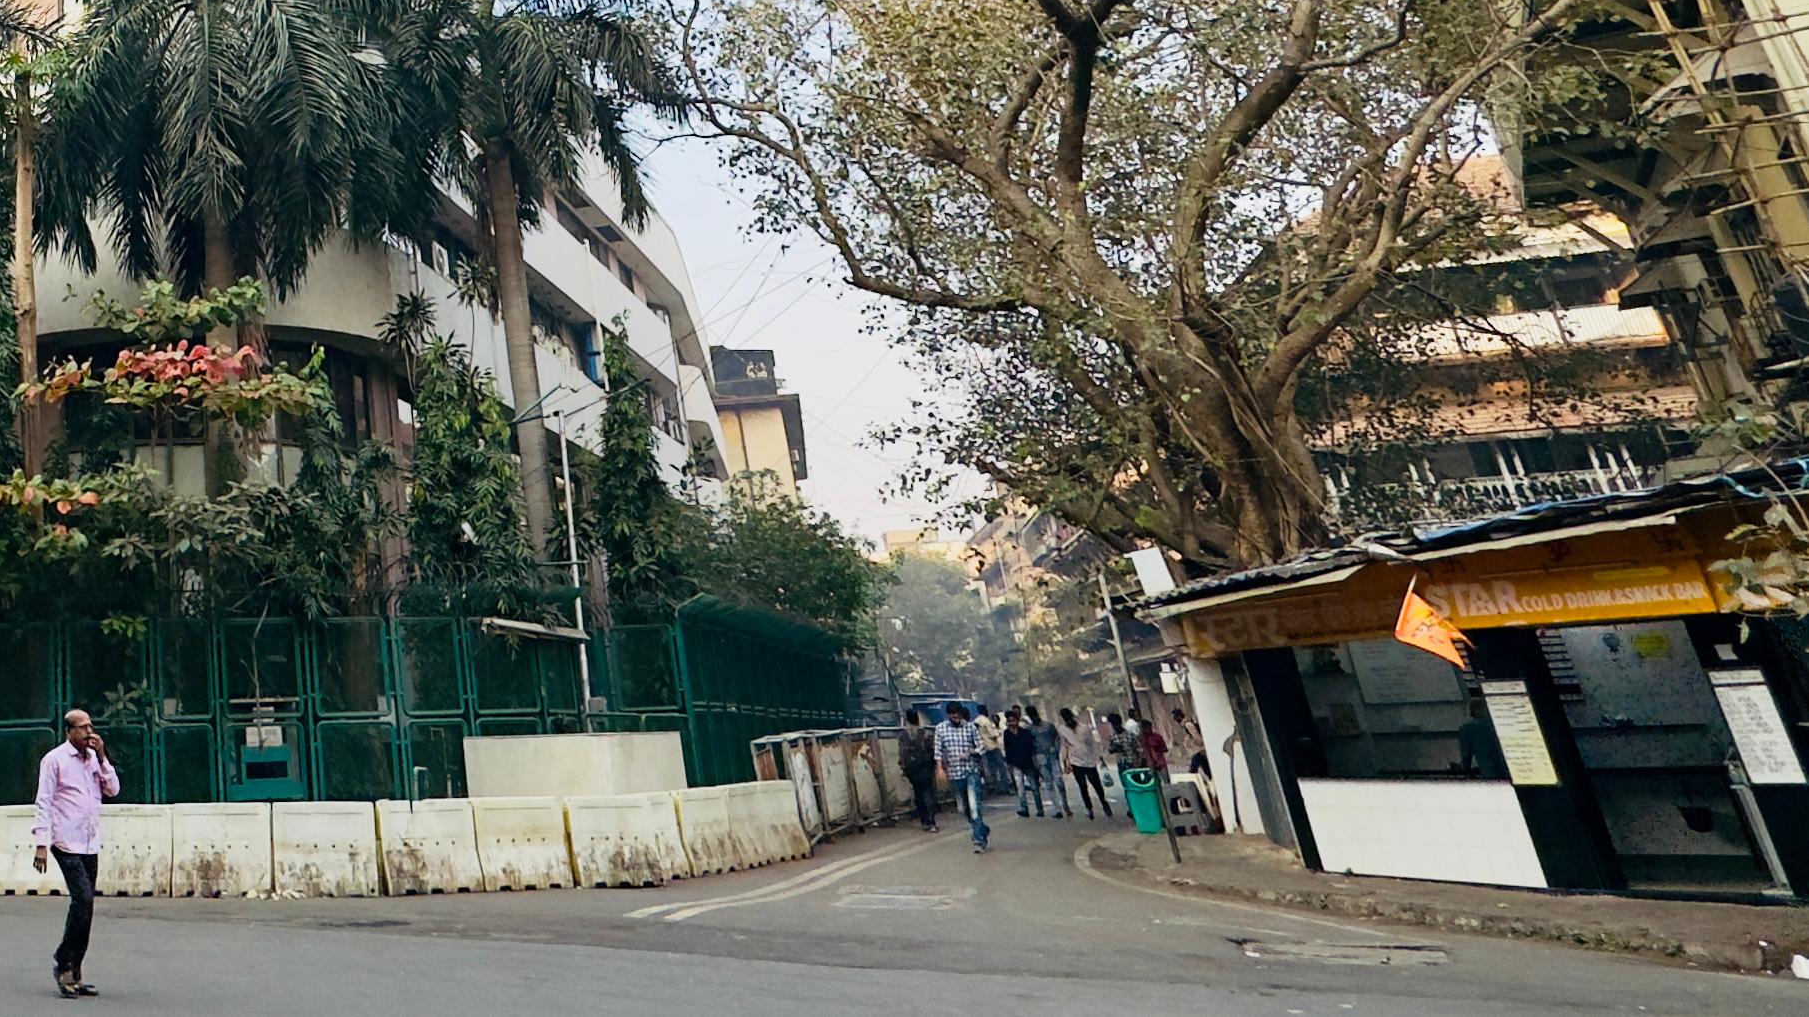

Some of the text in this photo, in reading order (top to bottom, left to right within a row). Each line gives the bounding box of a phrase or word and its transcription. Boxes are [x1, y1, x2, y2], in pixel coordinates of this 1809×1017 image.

[1425, 580, 1525, 619] STAR
[1521, 593, 1563, 613] COLD
[1674, 581, 1709, 601] BAR
